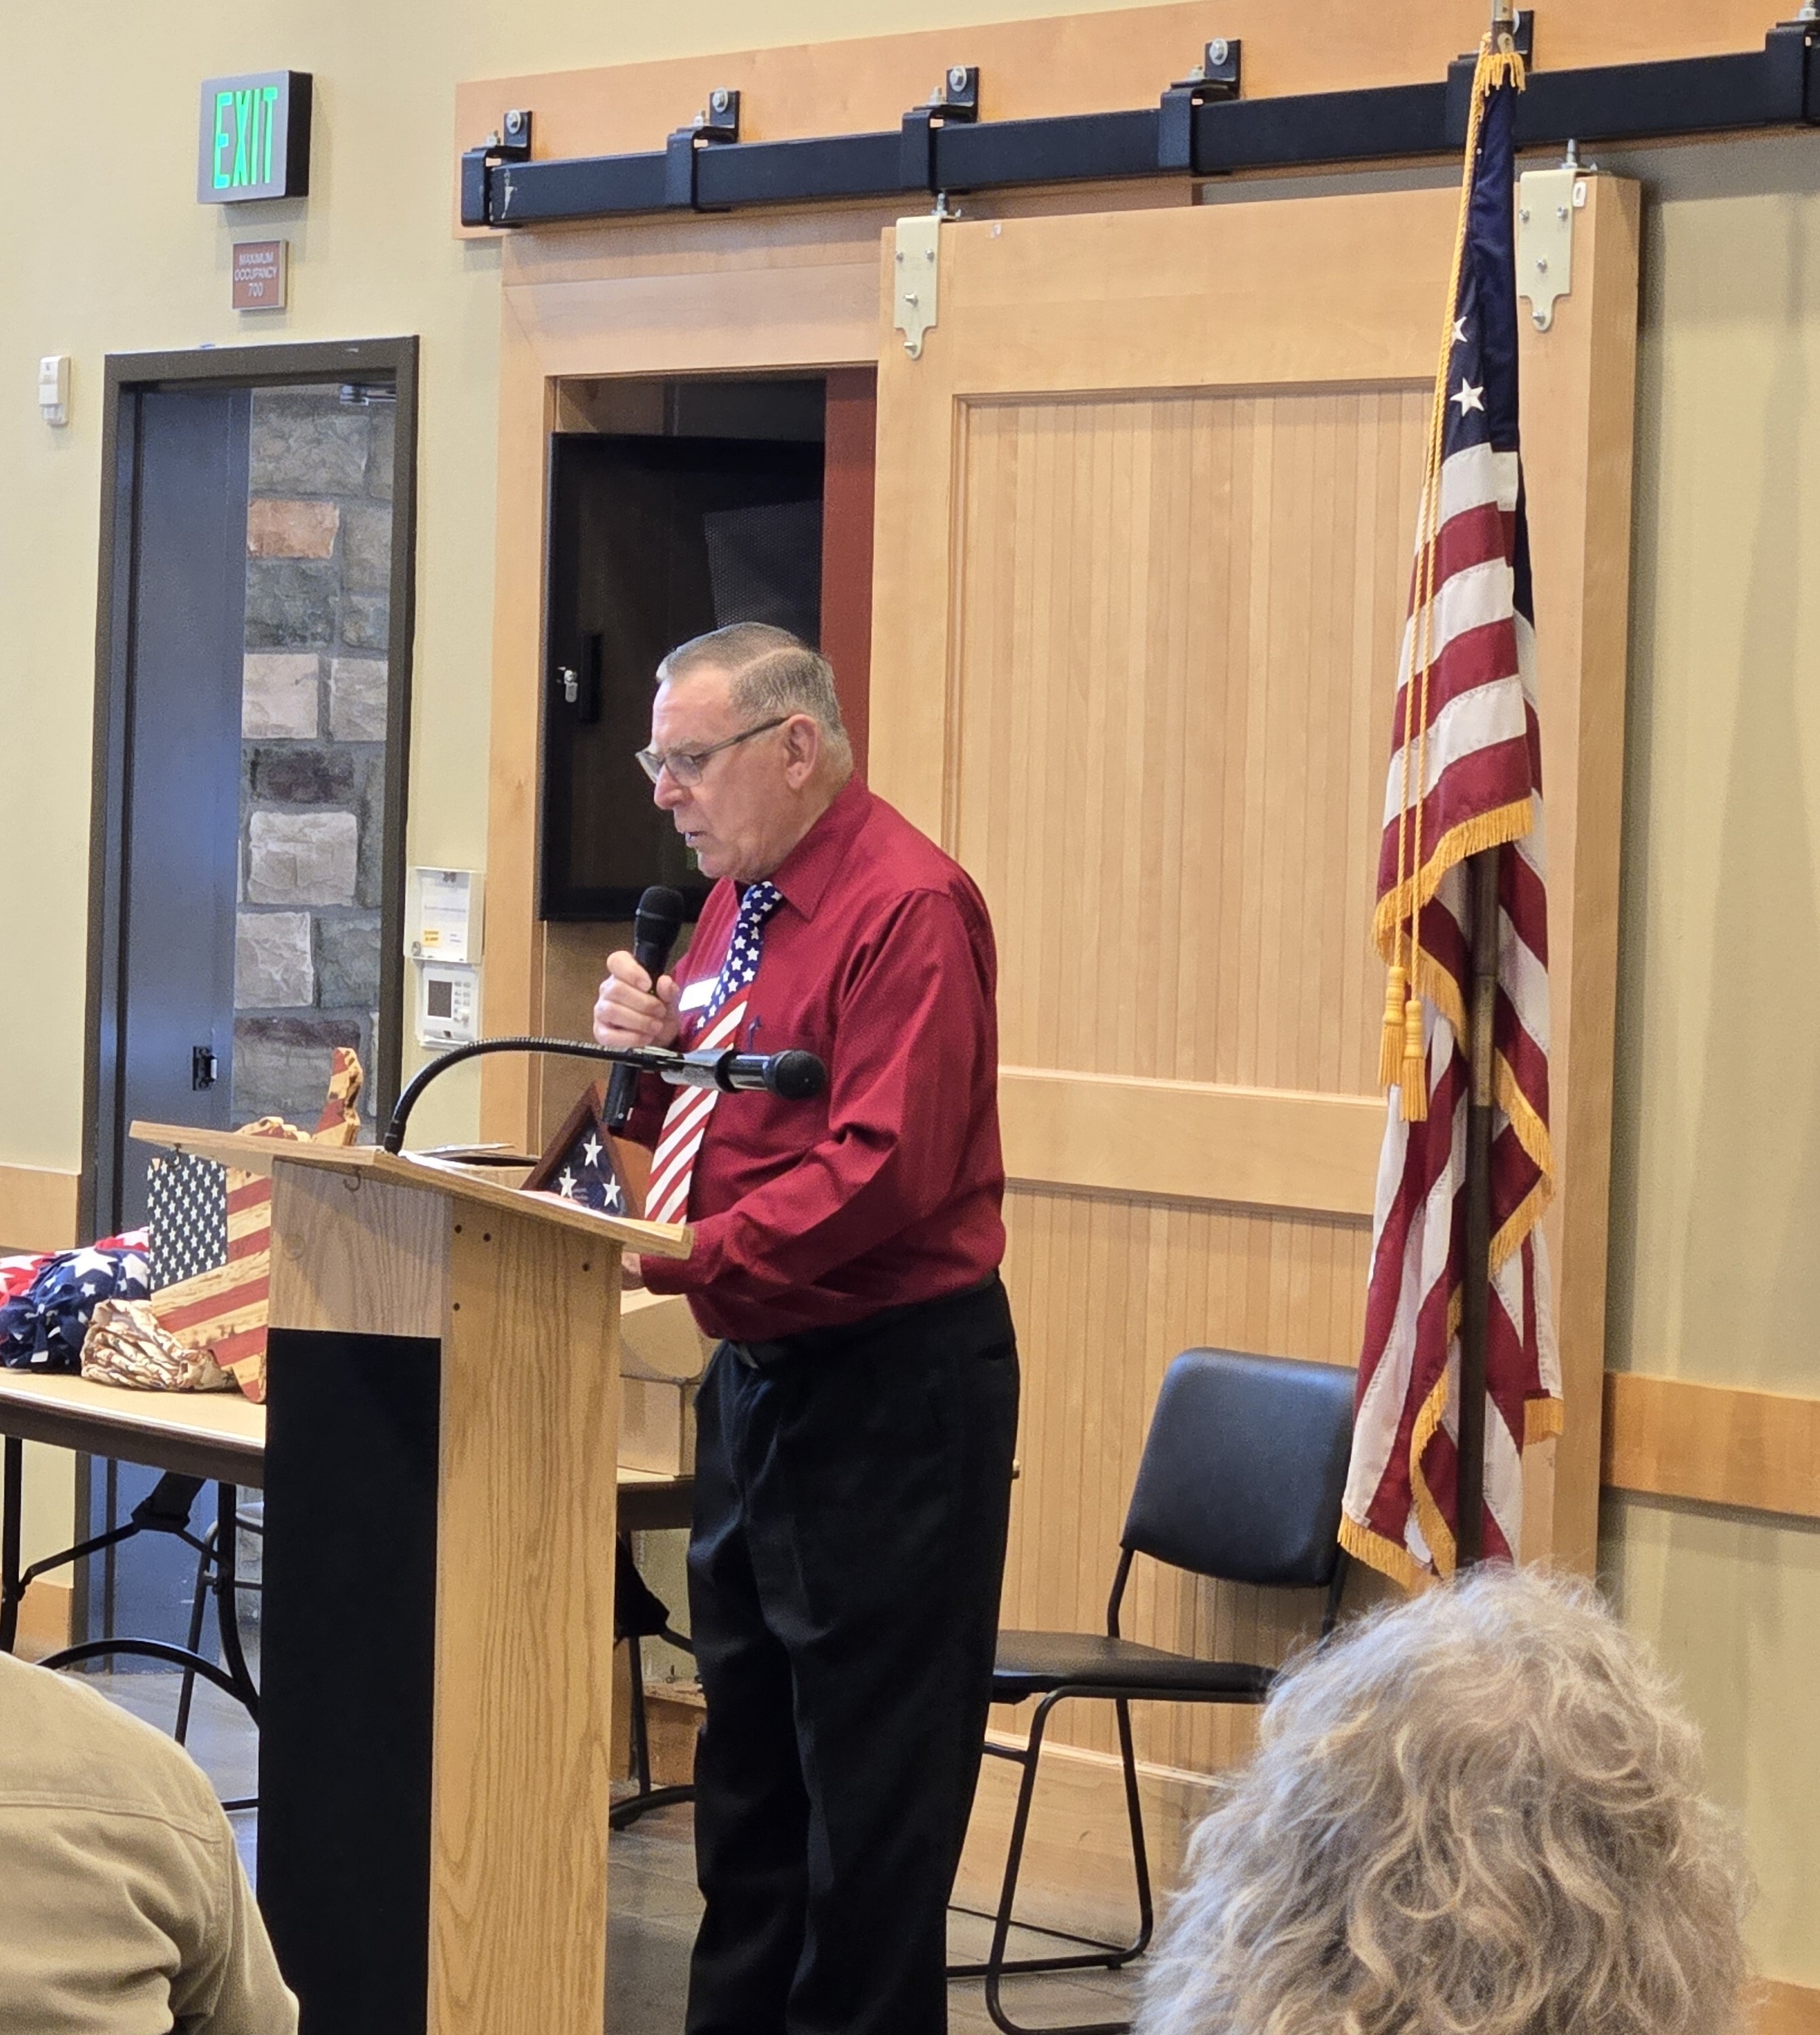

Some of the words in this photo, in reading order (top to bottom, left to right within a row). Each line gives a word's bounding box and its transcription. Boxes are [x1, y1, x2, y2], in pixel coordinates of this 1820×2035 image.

[213, 86, 279, 189] EXIT
[238, 251, 274, 265] MAXIMUM
[234, 266, 278, 282] OCCUPANCY
[248, 282, 264, 297] 700
